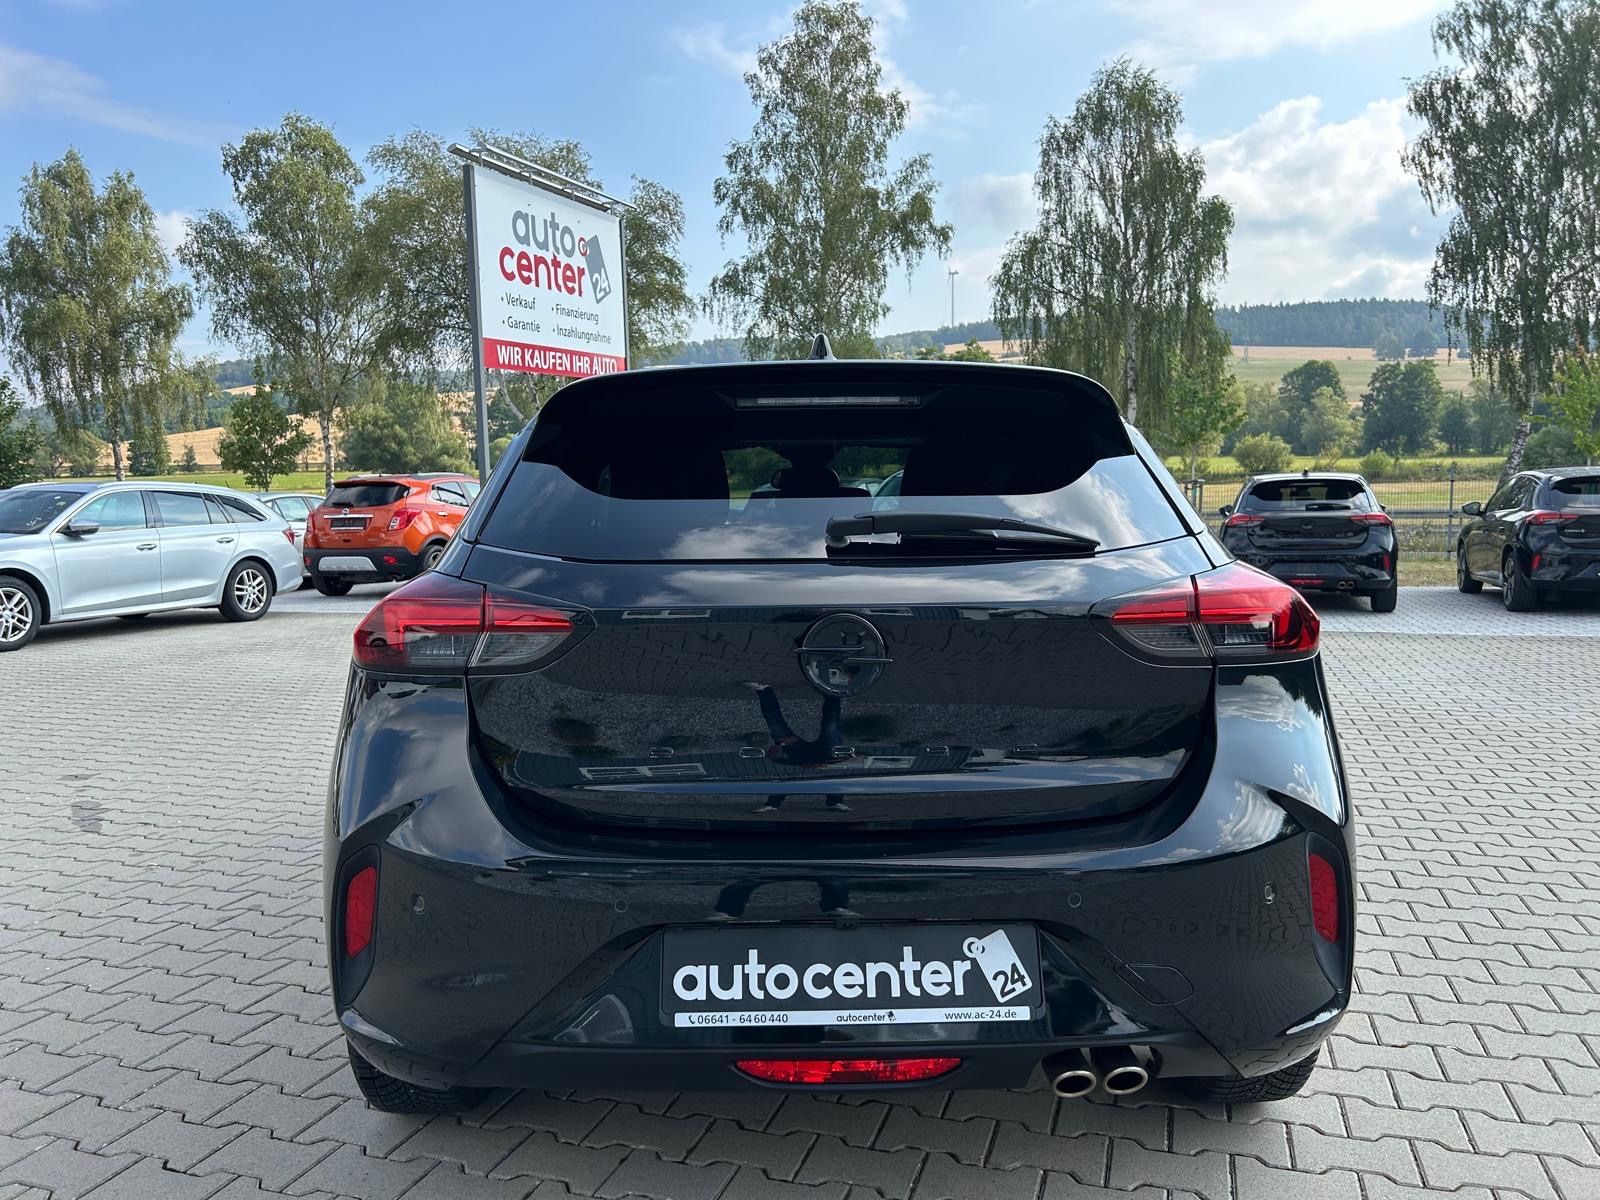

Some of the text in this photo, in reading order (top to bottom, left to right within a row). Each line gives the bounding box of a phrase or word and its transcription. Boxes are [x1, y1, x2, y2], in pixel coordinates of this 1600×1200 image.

[512, 210, 575, 258] auto
[499, 246, 585, 297] center
[592, 267, 609, 299] 24
[505, 292, 536, 310] Verkauf
[507, 316, 541, 333] Garantie
[556, 304, 599, 325] Finanzierung
[557, 324, 611, 344] Inzahlungnahme
[497, 344, 617, 375] WIR KAUFEN IHR AUTO
[992, 962, 1027, 998] 24
[697, 1014, 729, 1025] 06641
[944, 1009, 1017, 1020] www.ac-24.de
